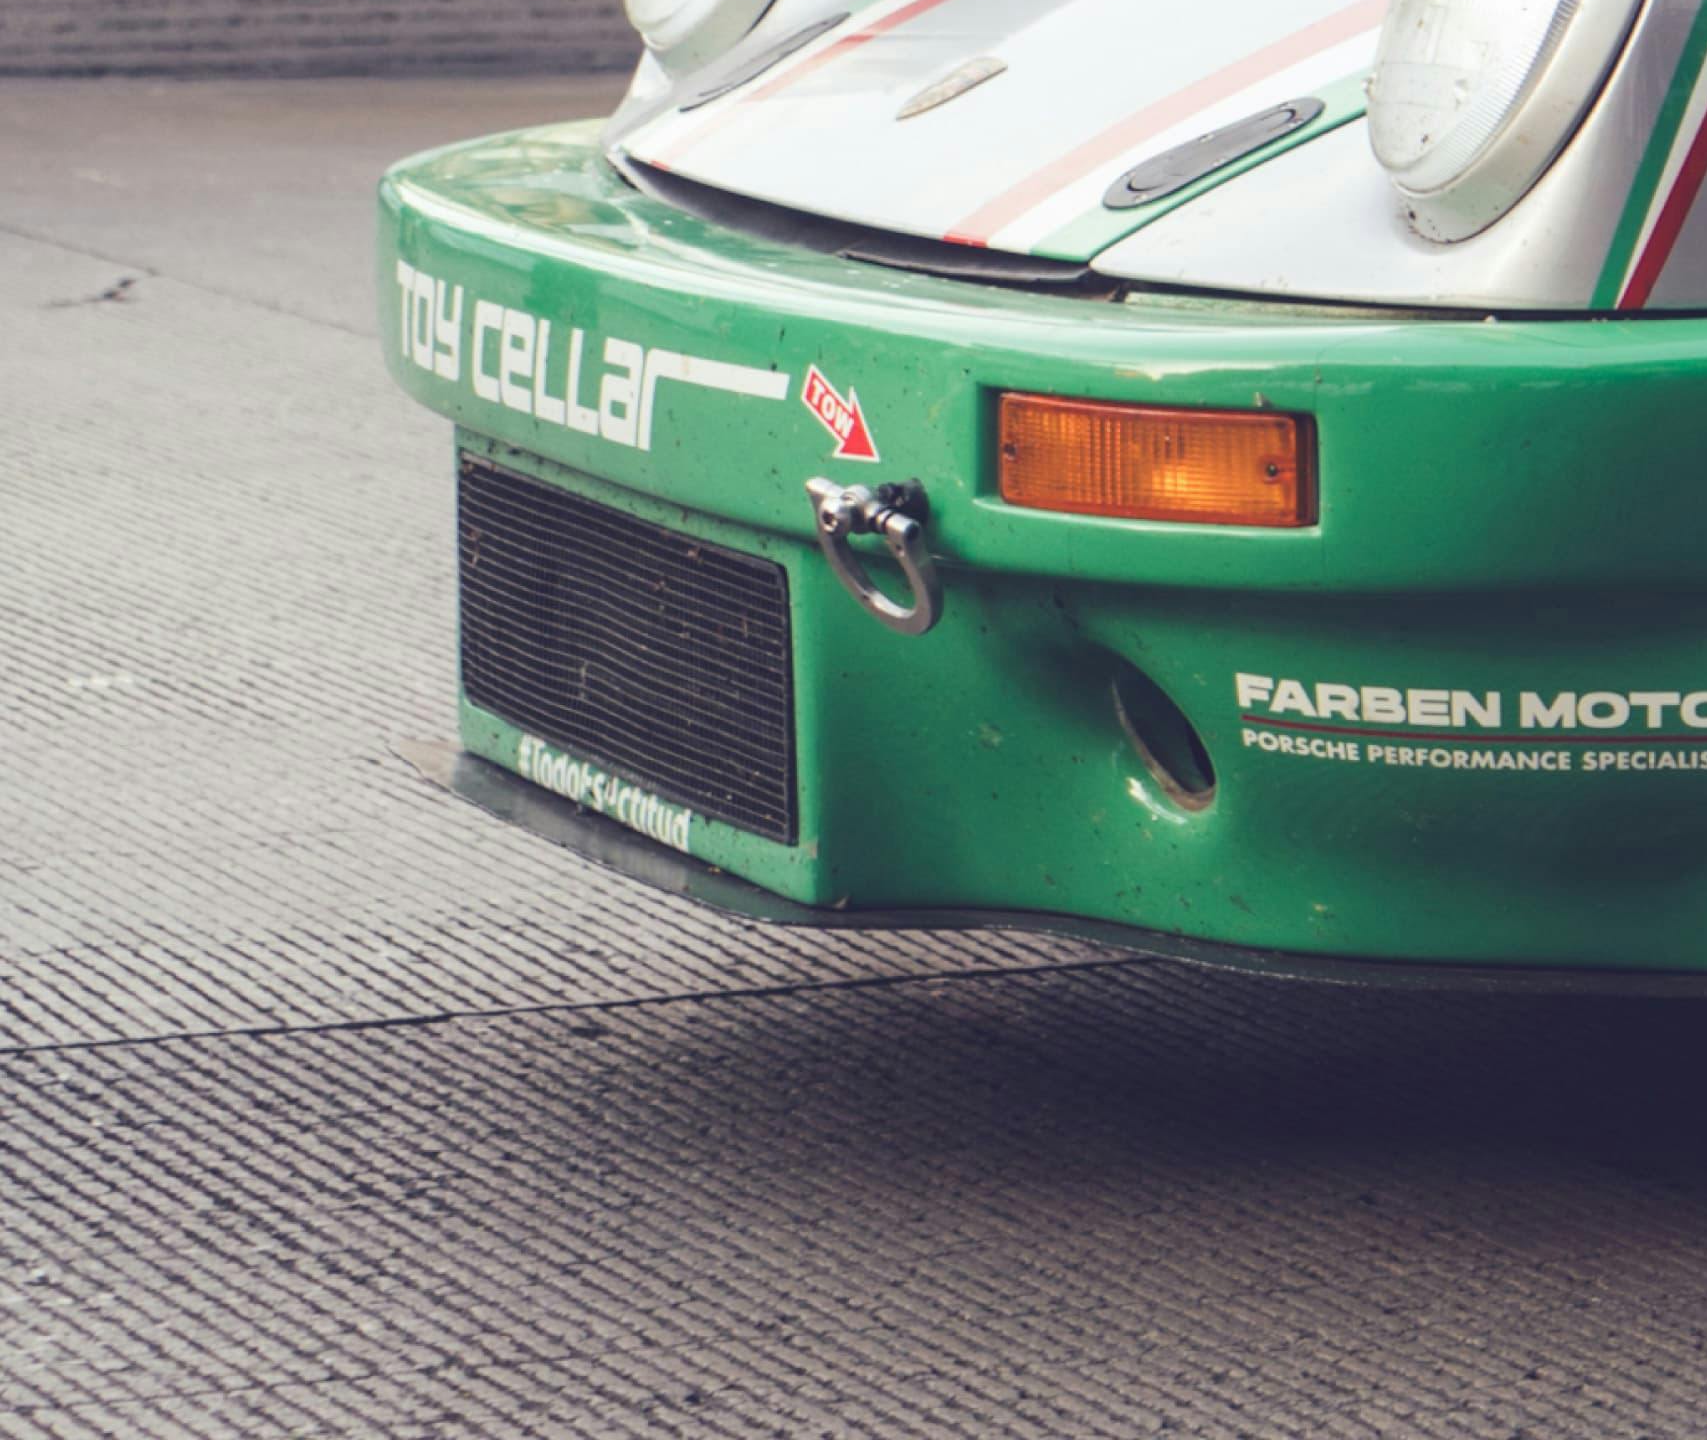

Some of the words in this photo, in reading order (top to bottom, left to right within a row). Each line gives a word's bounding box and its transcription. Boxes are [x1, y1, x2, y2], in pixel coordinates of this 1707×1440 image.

[811, 378, 855, 438] TOW
[1235, 672, 1501, 728] FARBEN
[1242, 728, 1360, 762] PORSCHE
[1367, 745, 1572, 772] PERFORMANCE
